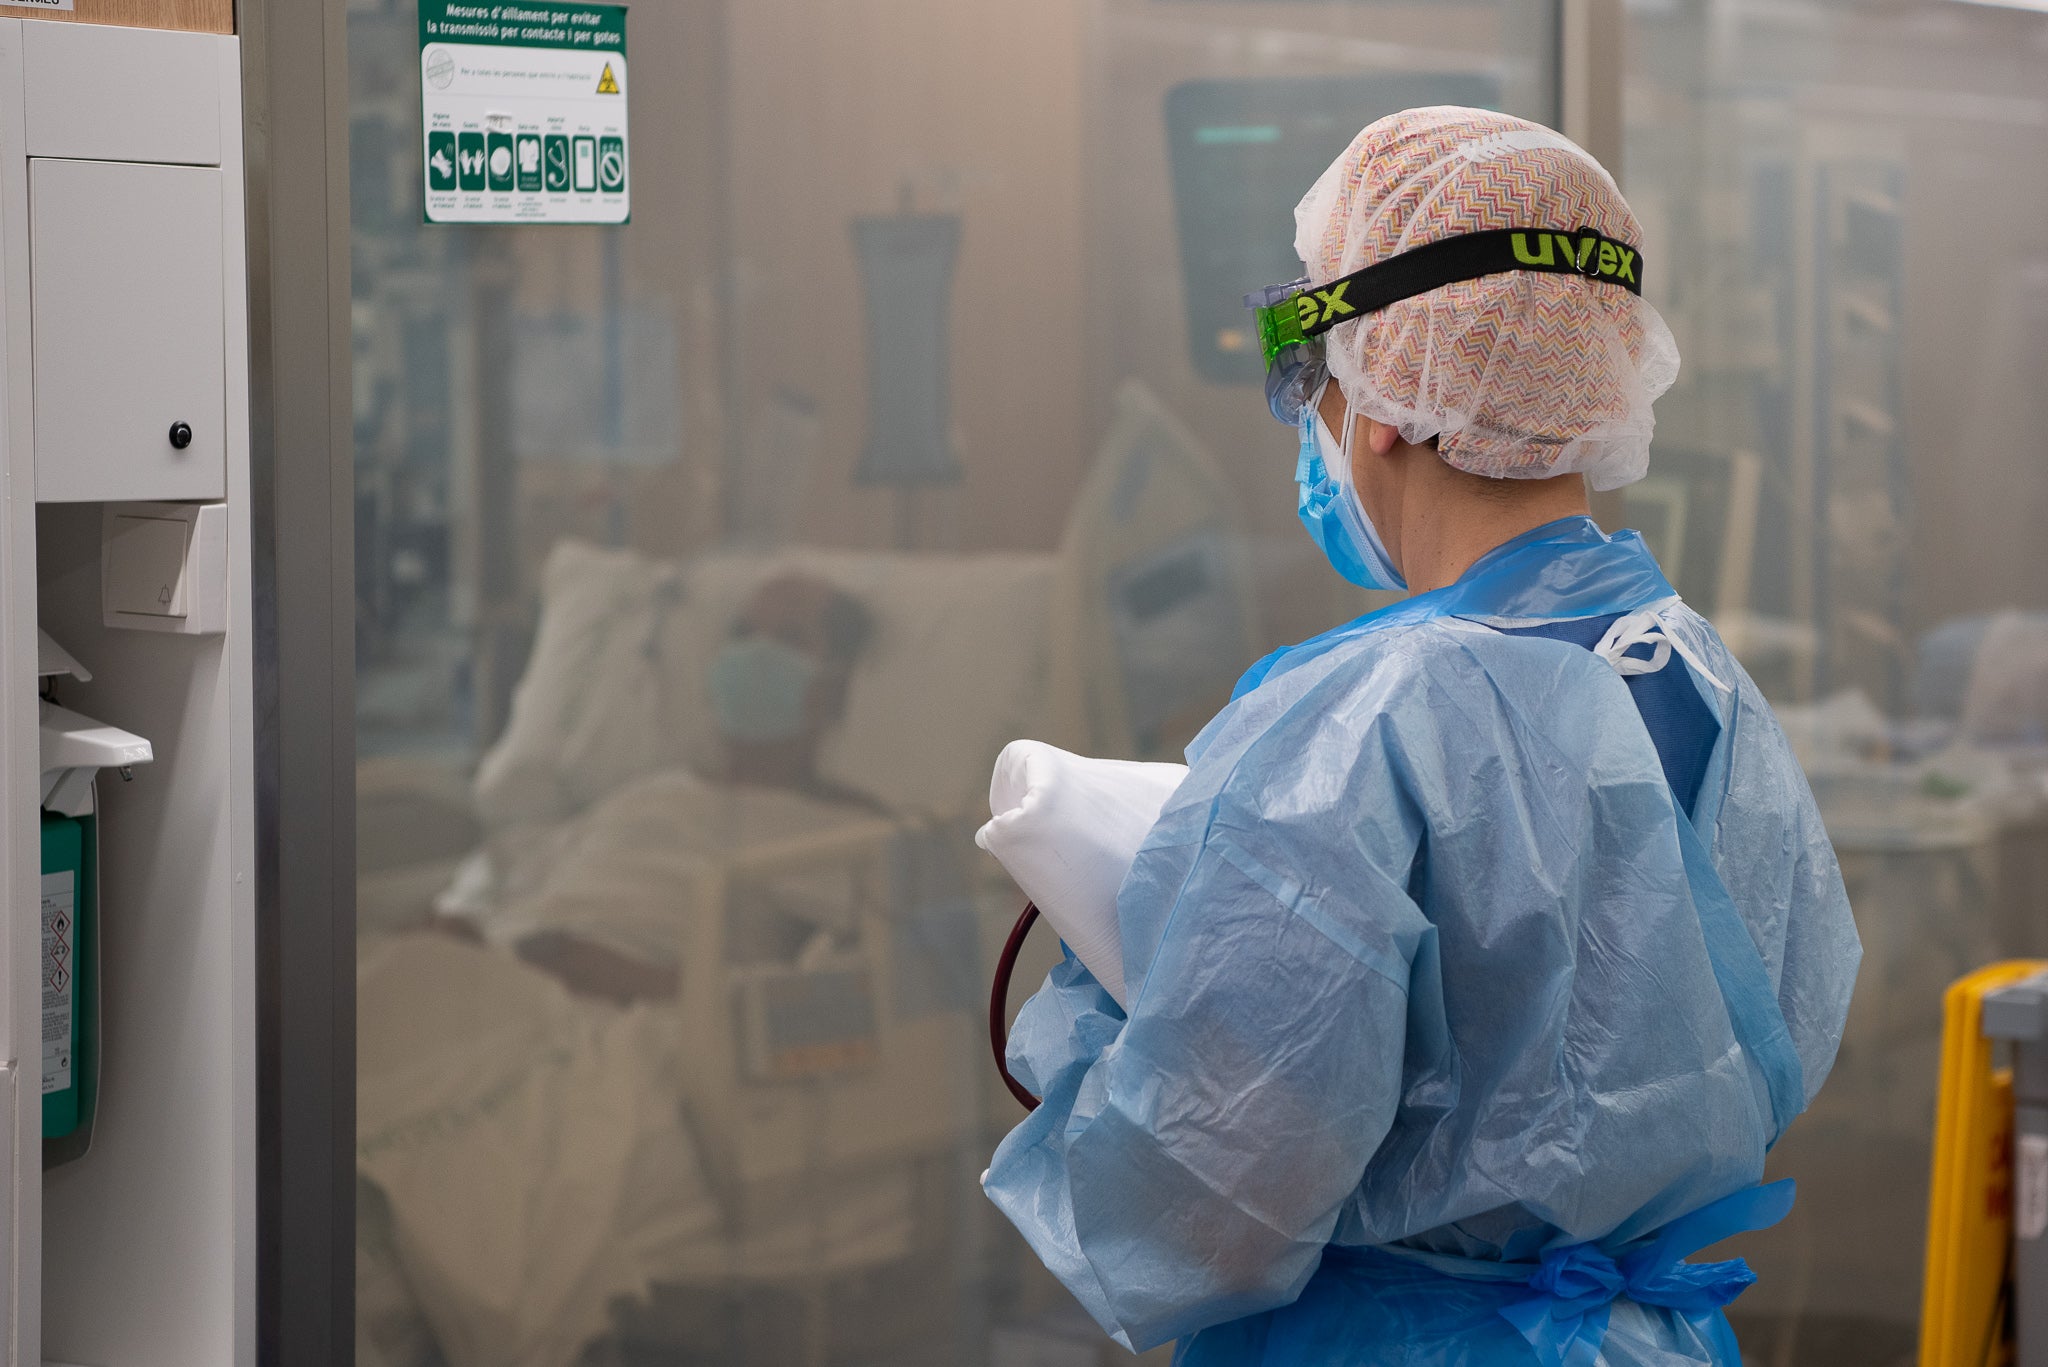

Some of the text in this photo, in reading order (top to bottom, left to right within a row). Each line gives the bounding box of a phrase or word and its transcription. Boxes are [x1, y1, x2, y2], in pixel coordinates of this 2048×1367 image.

[446, 3, 489, 19] Mesures
[551, 12, 569, 26] per
[571, 11, 602, 26] evitar
[427, 19, 620, 46] la transmissió per contacte i per gotes
[1511, 233, 1635, 284] uvex
